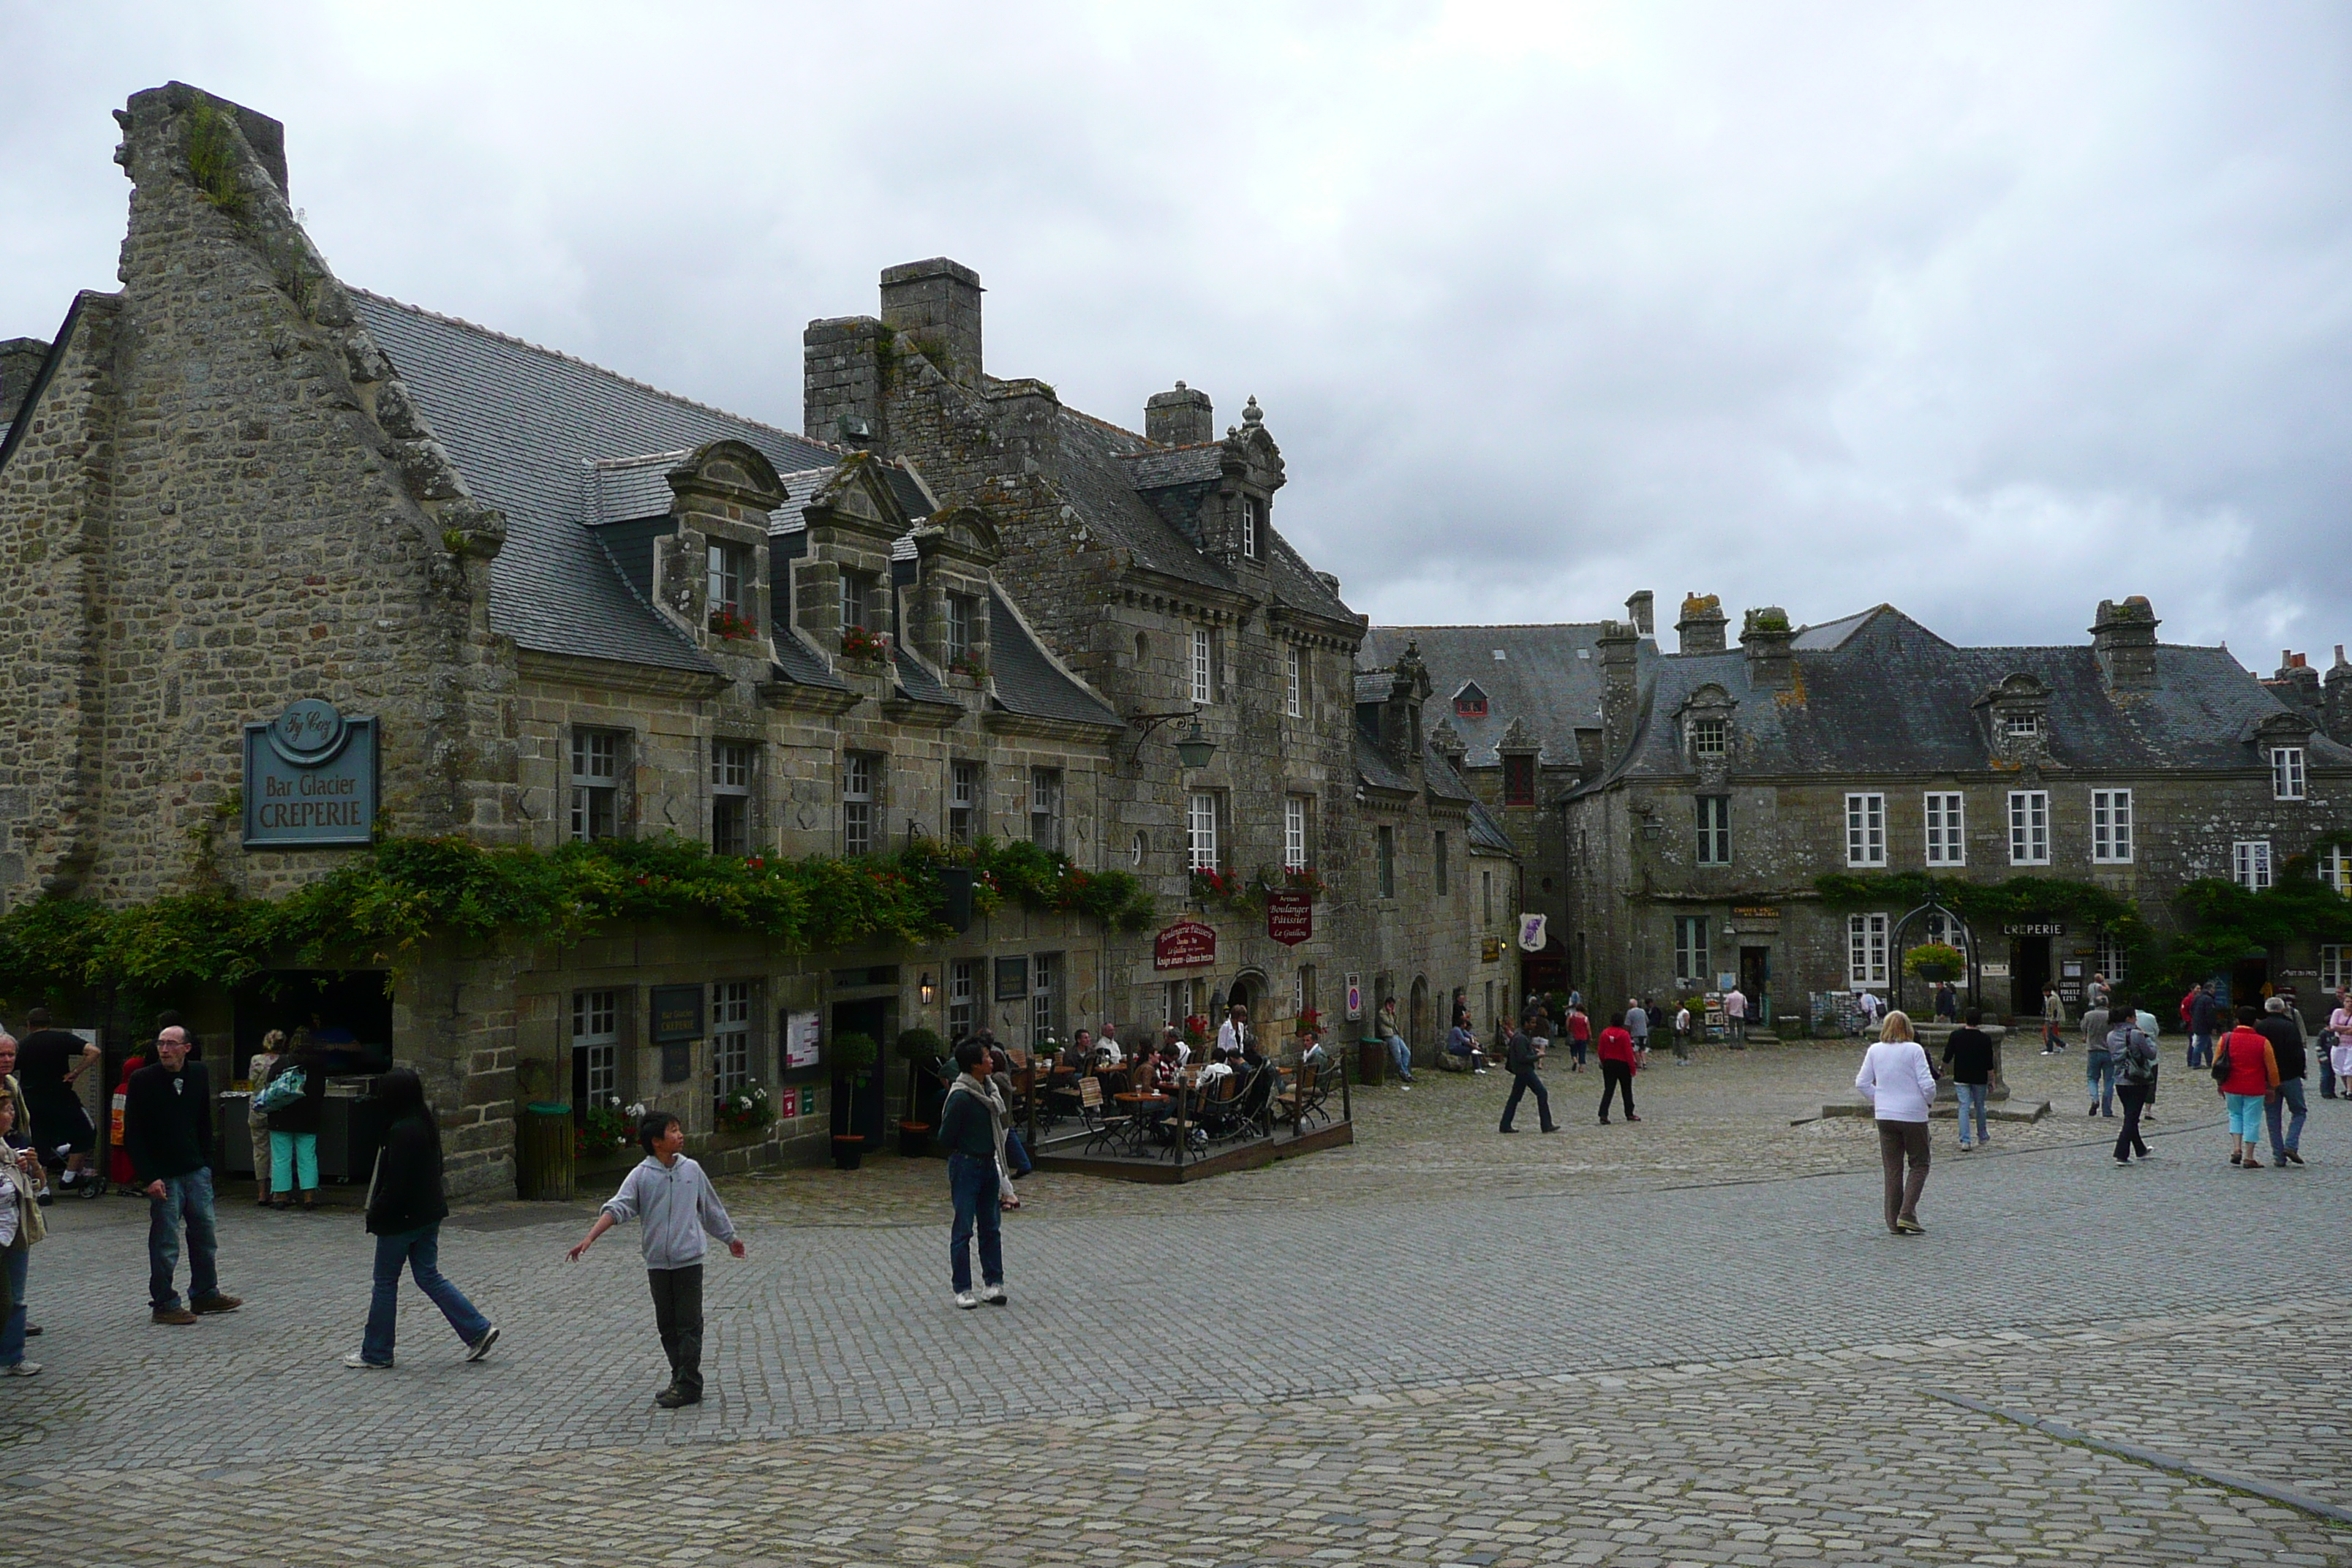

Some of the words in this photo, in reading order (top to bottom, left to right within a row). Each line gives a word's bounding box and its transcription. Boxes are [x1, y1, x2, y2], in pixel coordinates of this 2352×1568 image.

[285, 712, 304, 742] Ty
[265, 776, 293, 797] Bar
[299, 774, 356, 796] Glacier
[259, 801, 361, 828] CREPERIE
[1269, 903, 1309, 916] Boulanger
[1272, 914, 1308, 924] Pâtissier
[1161, 925, 1190, 943] Boulangerie
[1274, 929, 1283, 937] Le
[1284, 928, 1306, 938] Guillou
